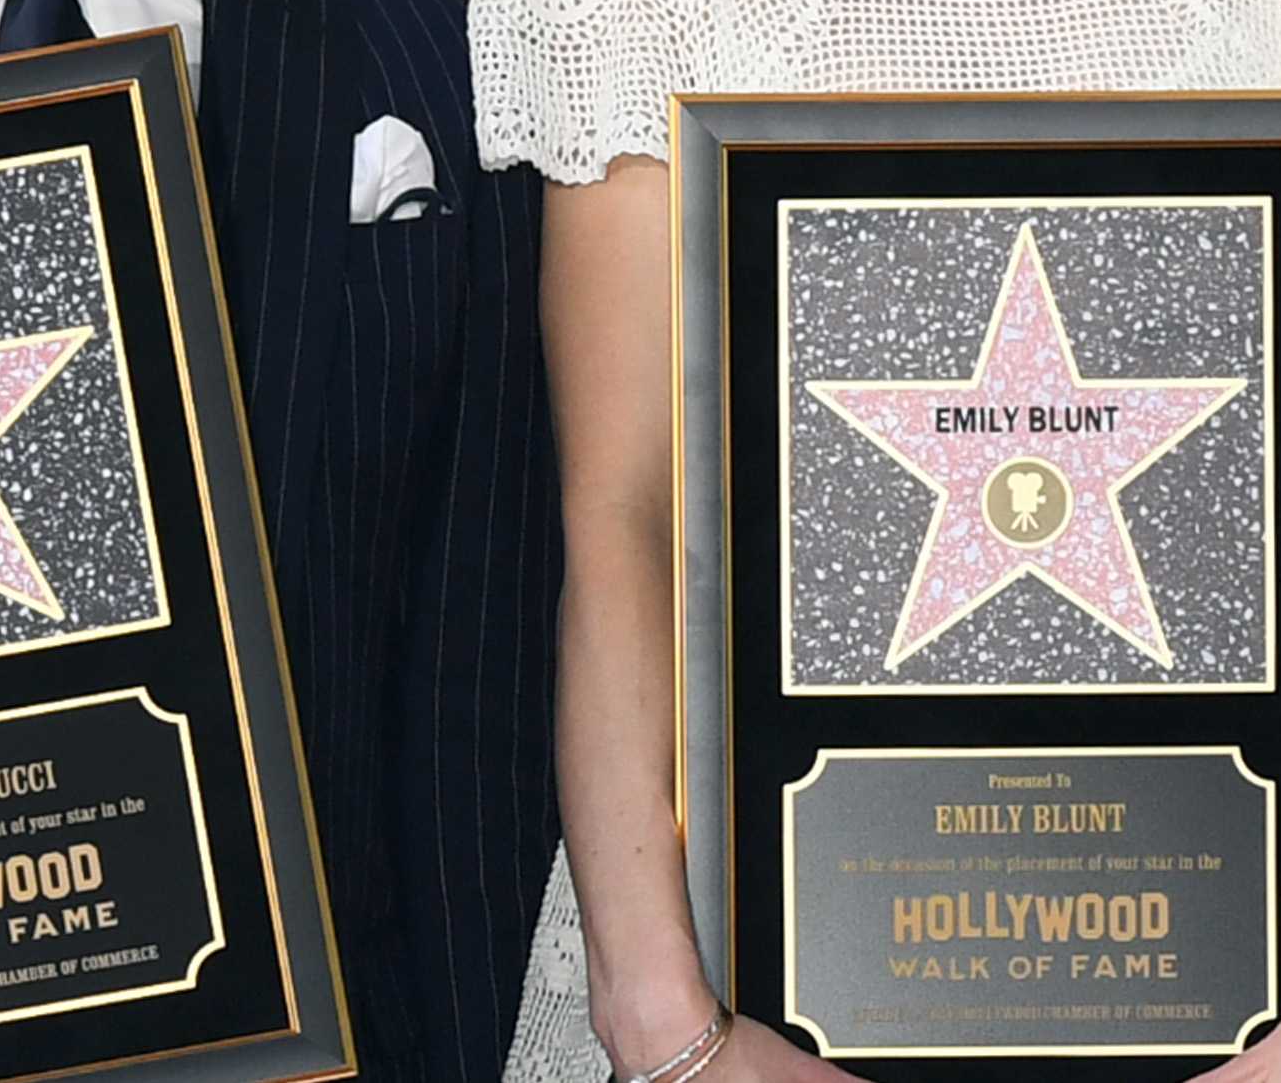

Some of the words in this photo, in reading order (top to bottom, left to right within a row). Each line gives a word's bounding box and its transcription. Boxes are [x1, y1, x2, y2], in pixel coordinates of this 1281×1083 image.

[936, 406, 1019, 433] EMILY
[1029, 406, 1119, 433] BLUNT
[989, 773, 1052, 789] Presented
[1056, 773, 1072, 788] To
[10, 815, 26, 835] of
[29, 813, 63, 835] your
[66, 806, 97, 824] star
[101, 801, 117, 818] in
[120, 797, 145, 815] the
[935, 804, 1023, 834] EMILY
[1033, 803, 1126, 833] BLUNT
[977, 854, 1002, 871] the
[1007, 854, 1083, 875] placement
[1087, 853, 1103, 871] of
[1144, 855, 1173, 870] star
[1178, 854, 1194, 870] in
[1197, 852, 1222, 871] the
[9, 901, 119, 944] FAME
[894, 890, 1170, 943] HOLLYWOOD
[60, 959, 79, 975] OF
[81, 944, 159, 972] COMMERCE
[888, 956, 990, 981] WALK
[1008, 955, 1053, 980] OF
[1071, 954, 1178, 979] FAME
[1113, 1004, 1132, 1021] OF
[1135, 1003, 1215, 1021] COMMERCE
